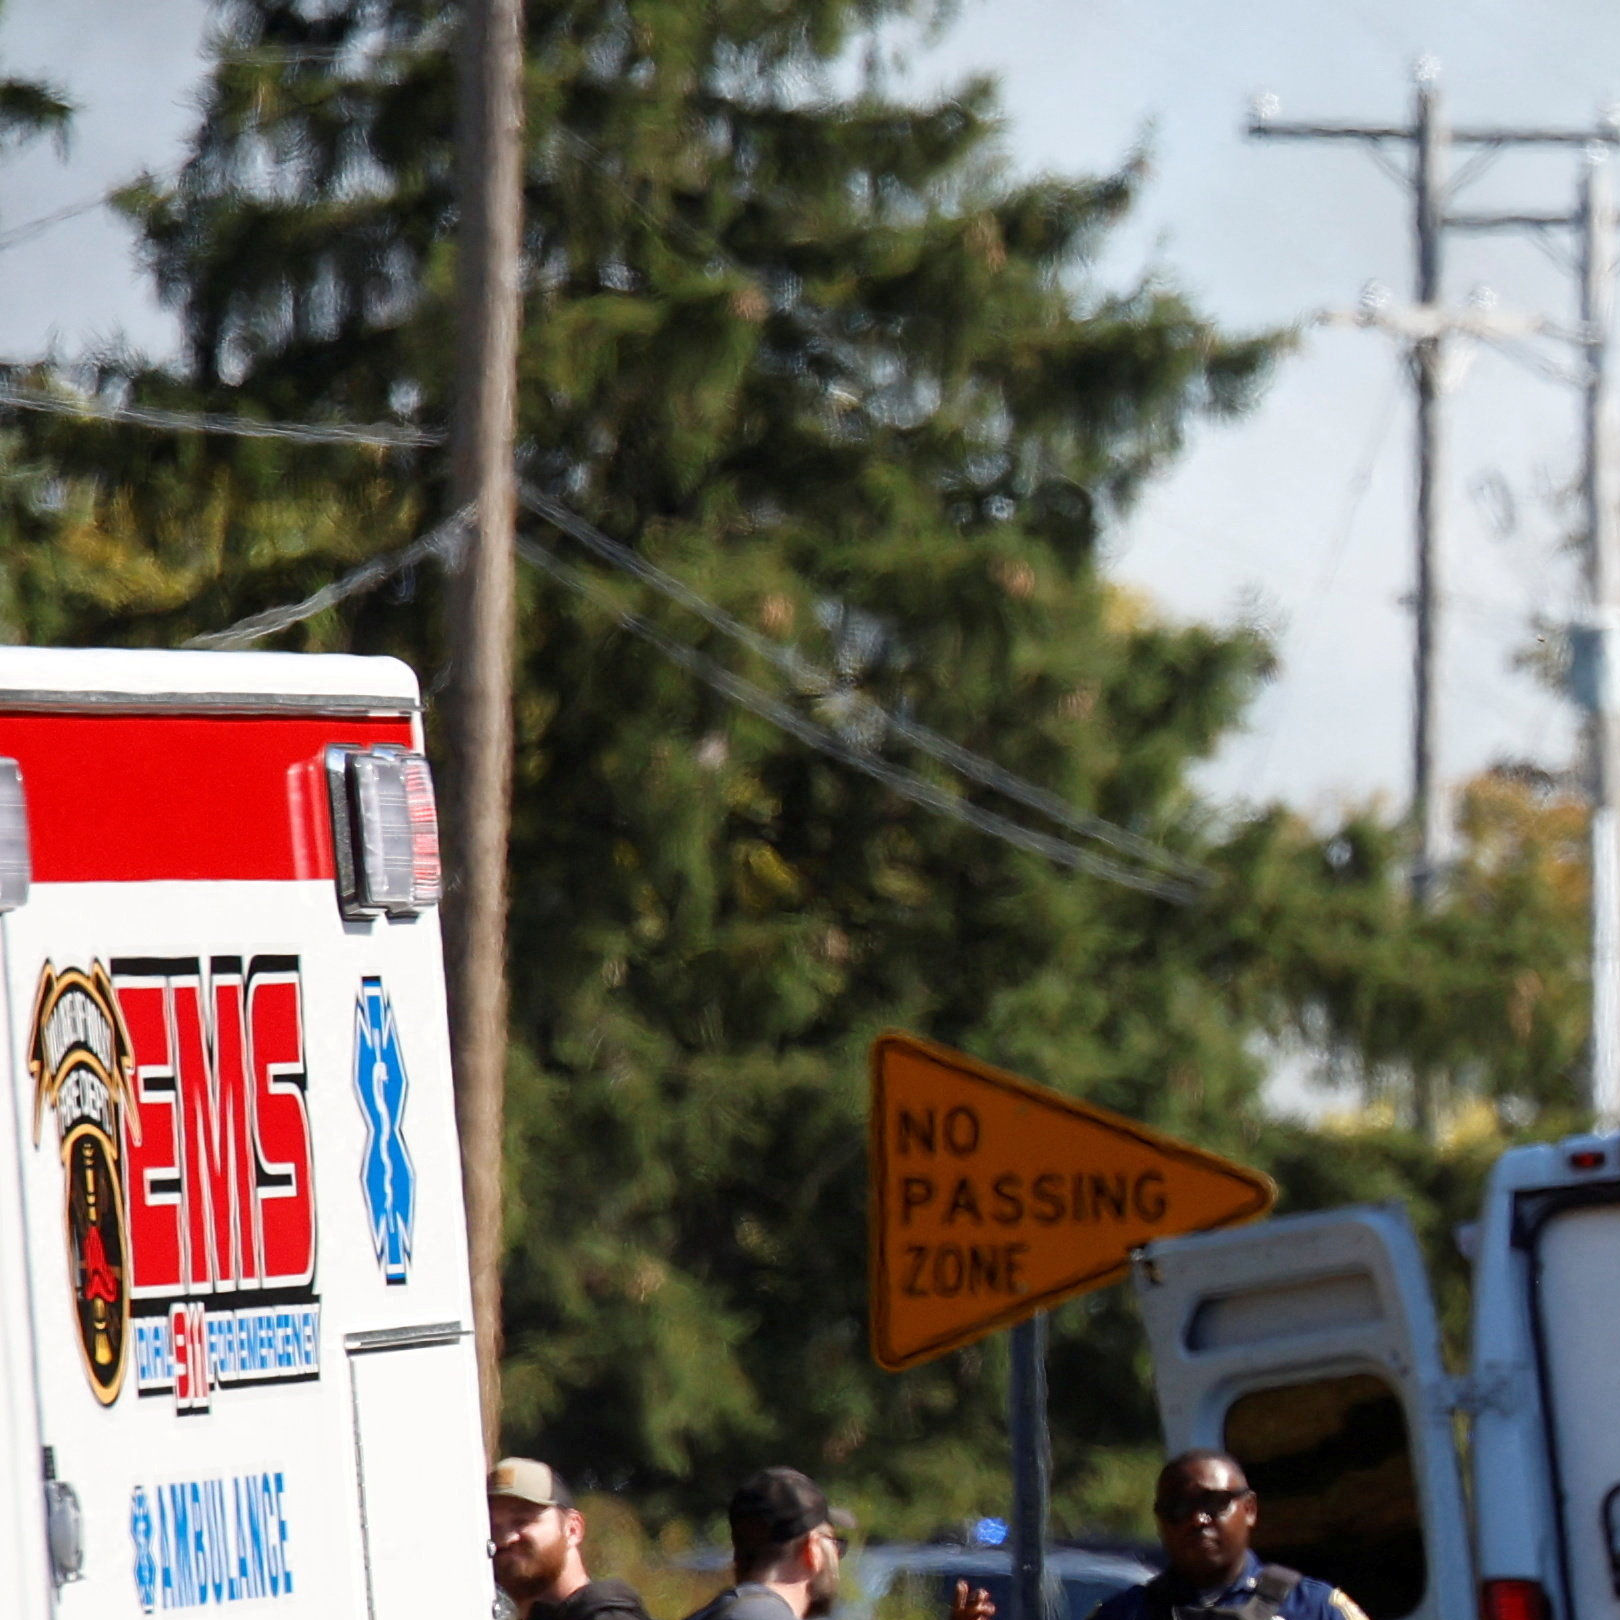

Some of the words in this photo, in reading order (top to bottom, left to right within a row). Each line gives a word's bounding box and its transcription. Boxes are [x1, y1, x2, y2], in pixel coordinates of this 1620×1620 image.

[115, 978, 315, 1291] EMS
[898, 1105, 981, 1156] NO
[902, 1169, 1167, 1226] PASSING
[905, 1242, 1029, 1298] ZONE
[173, 1309, 209, 1400] 911
[207, 1319, 235, 1374] FOR
[157, 1471, 293, 1610] AMBULANCE
